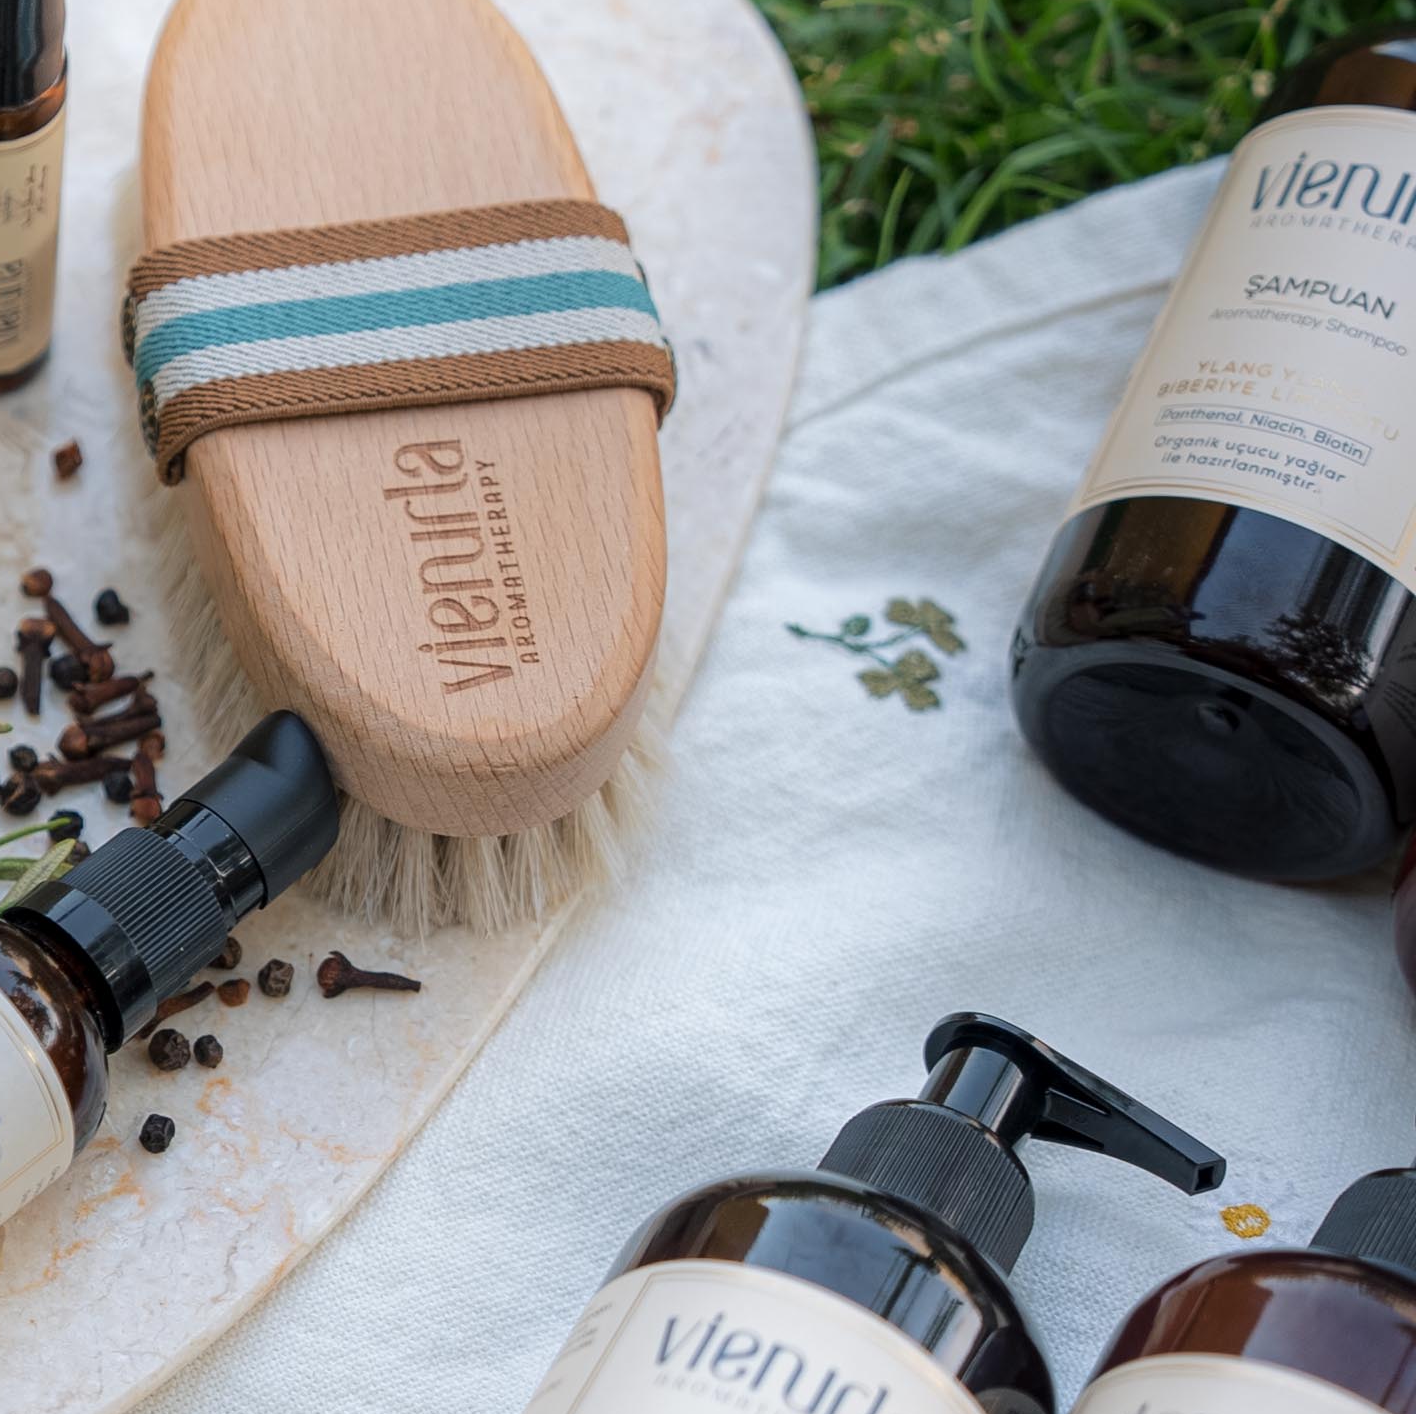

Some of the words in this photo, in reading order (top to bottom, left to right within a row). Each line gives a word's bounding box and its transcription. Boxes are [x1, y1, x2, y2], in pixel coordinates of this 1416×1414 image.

[1244, 274, 1396, 320] ŞAMPUAN
[1325, 318, 1408, 357] Shampoo
[1154, 435, 1220, 452] Organik
[1224, 440, 1281, 462] uçucu
[1284, 453, 1347, 484] yağlar
[1249, 413, 1307, 440] Niacin,
[1313, 428, 1365, 462] Biotin
[382, 438, 515, 695] vienurla
[474, 459, 541, 665] AROMATHERAPY
